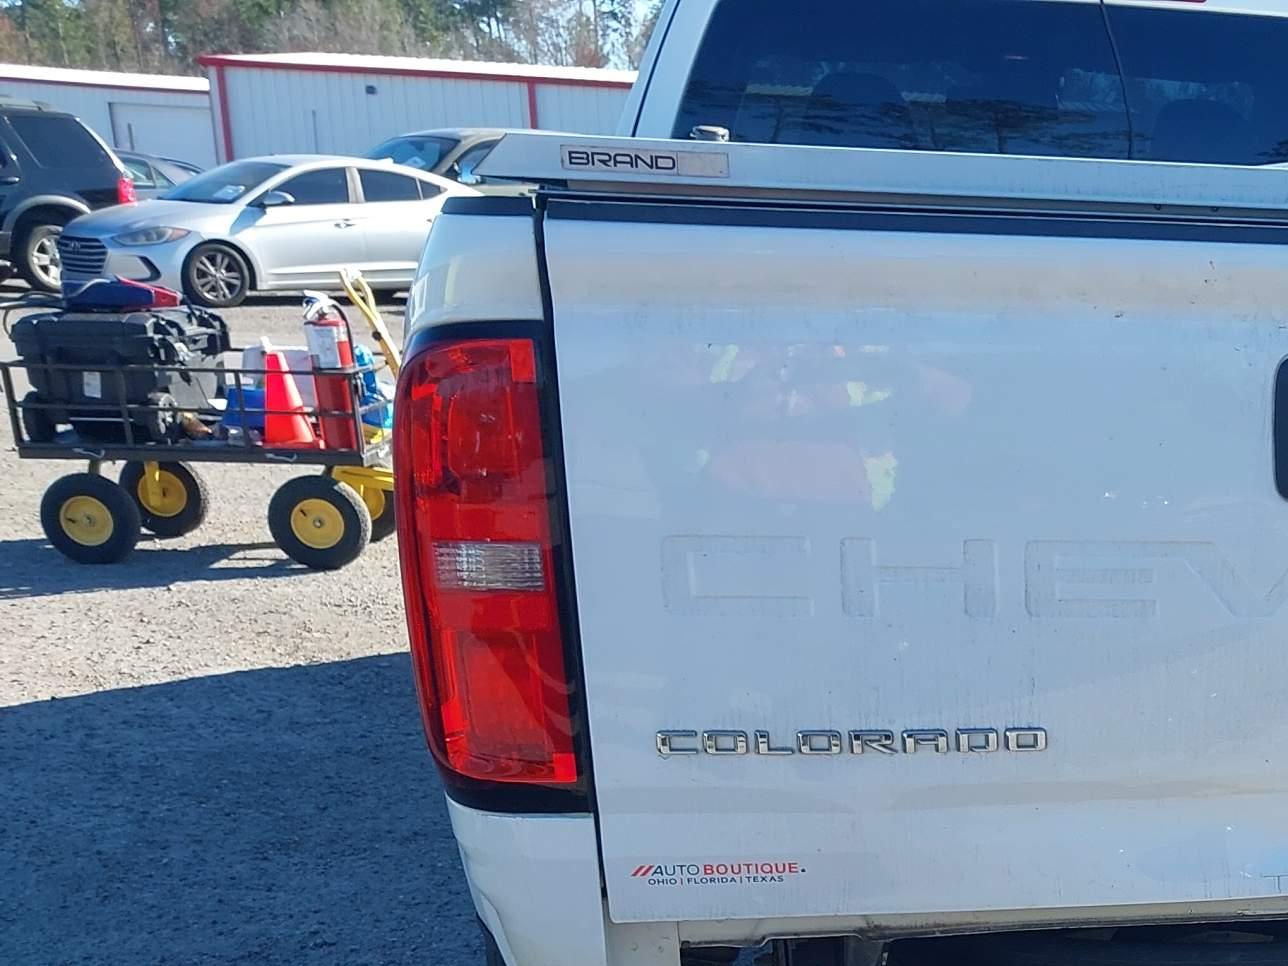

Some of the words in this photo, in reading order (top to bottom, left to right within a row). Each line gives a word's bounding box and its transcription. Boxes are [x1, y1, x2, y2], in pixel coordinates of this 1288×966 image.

[568, 150, 676, 171] BRAND
[655, 727, 1048, 755] COLORADO
[647, 878, 677, 886] OHIO
[687, 876, 737, 885] FLORIDA
[745, 875, 785, 884] TEXAS
